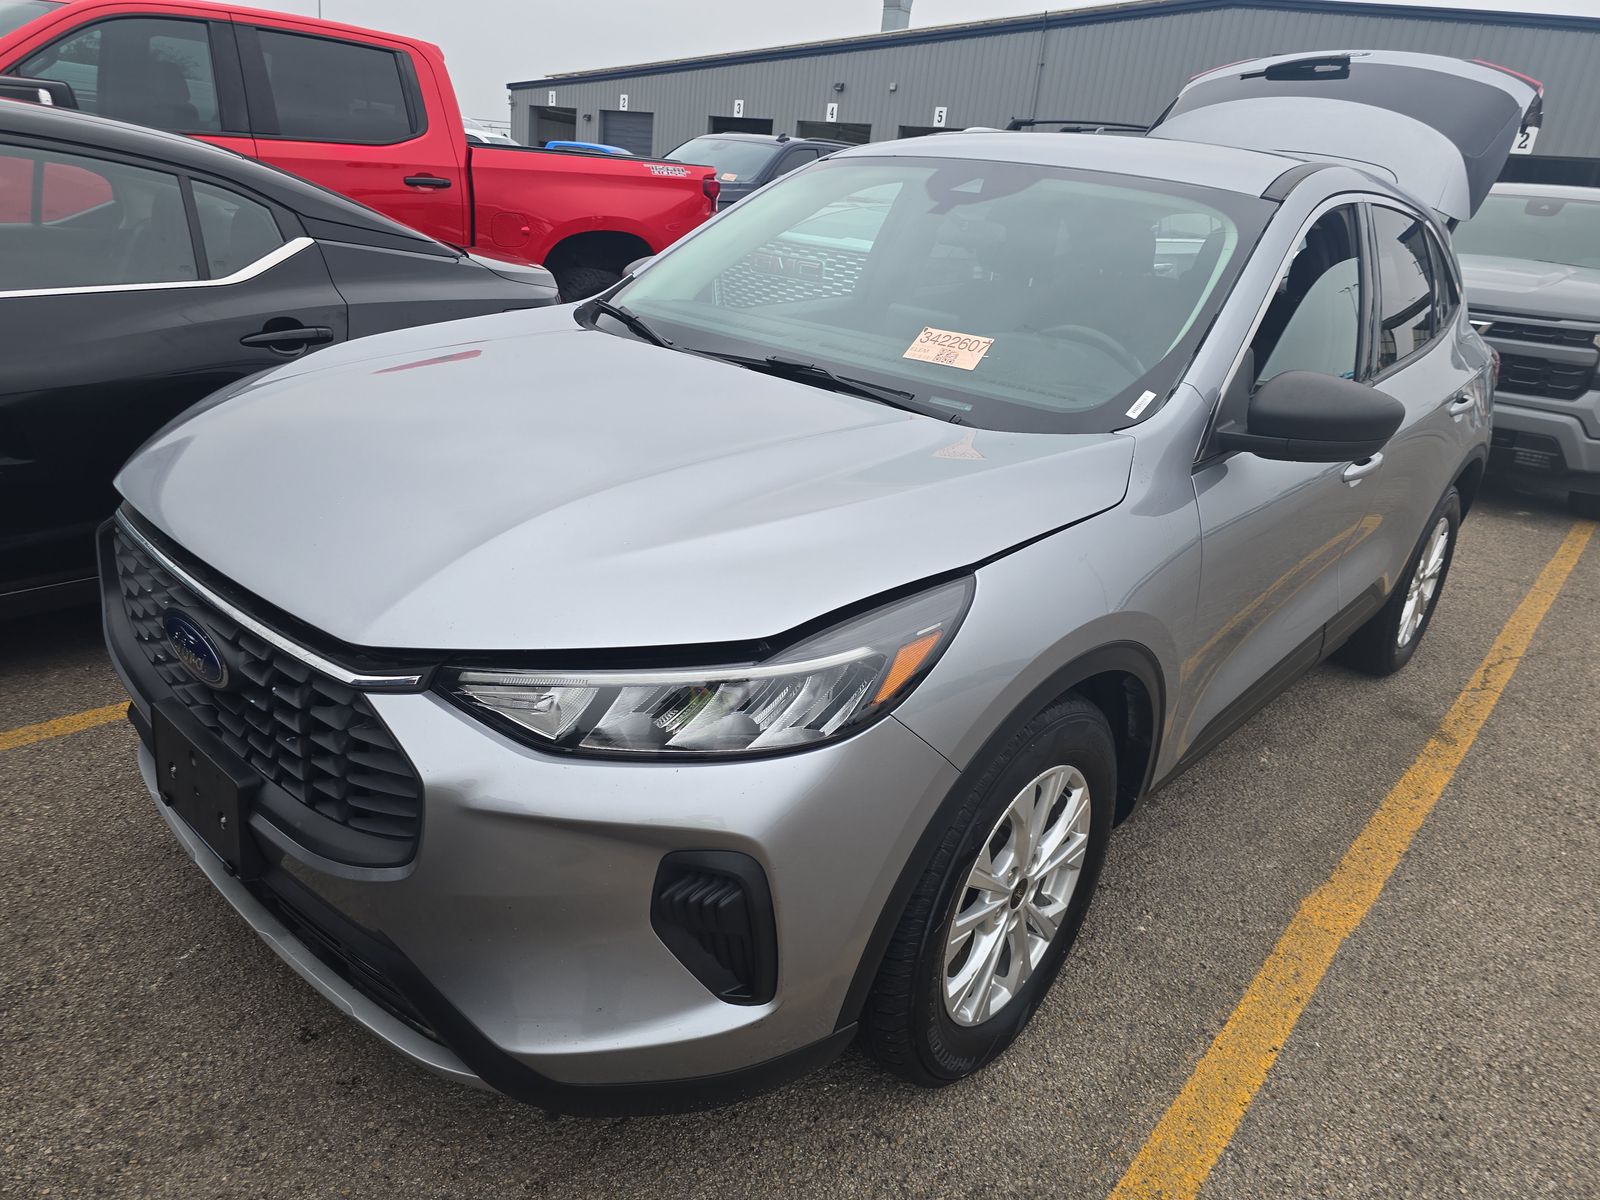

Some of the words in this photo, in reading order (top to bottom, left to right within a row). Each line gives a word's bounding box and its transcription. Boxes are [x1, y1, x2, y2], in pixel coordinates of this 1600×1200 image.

[736, 103, 742, 114] 3
[829, 106, 836, 119] 4
[936, 110, 944, 123] 5
[1517, 132, 1531, 149] 2
[751, 254, 820, 282] GMC
[919, 331, 991, 353] 3422607
